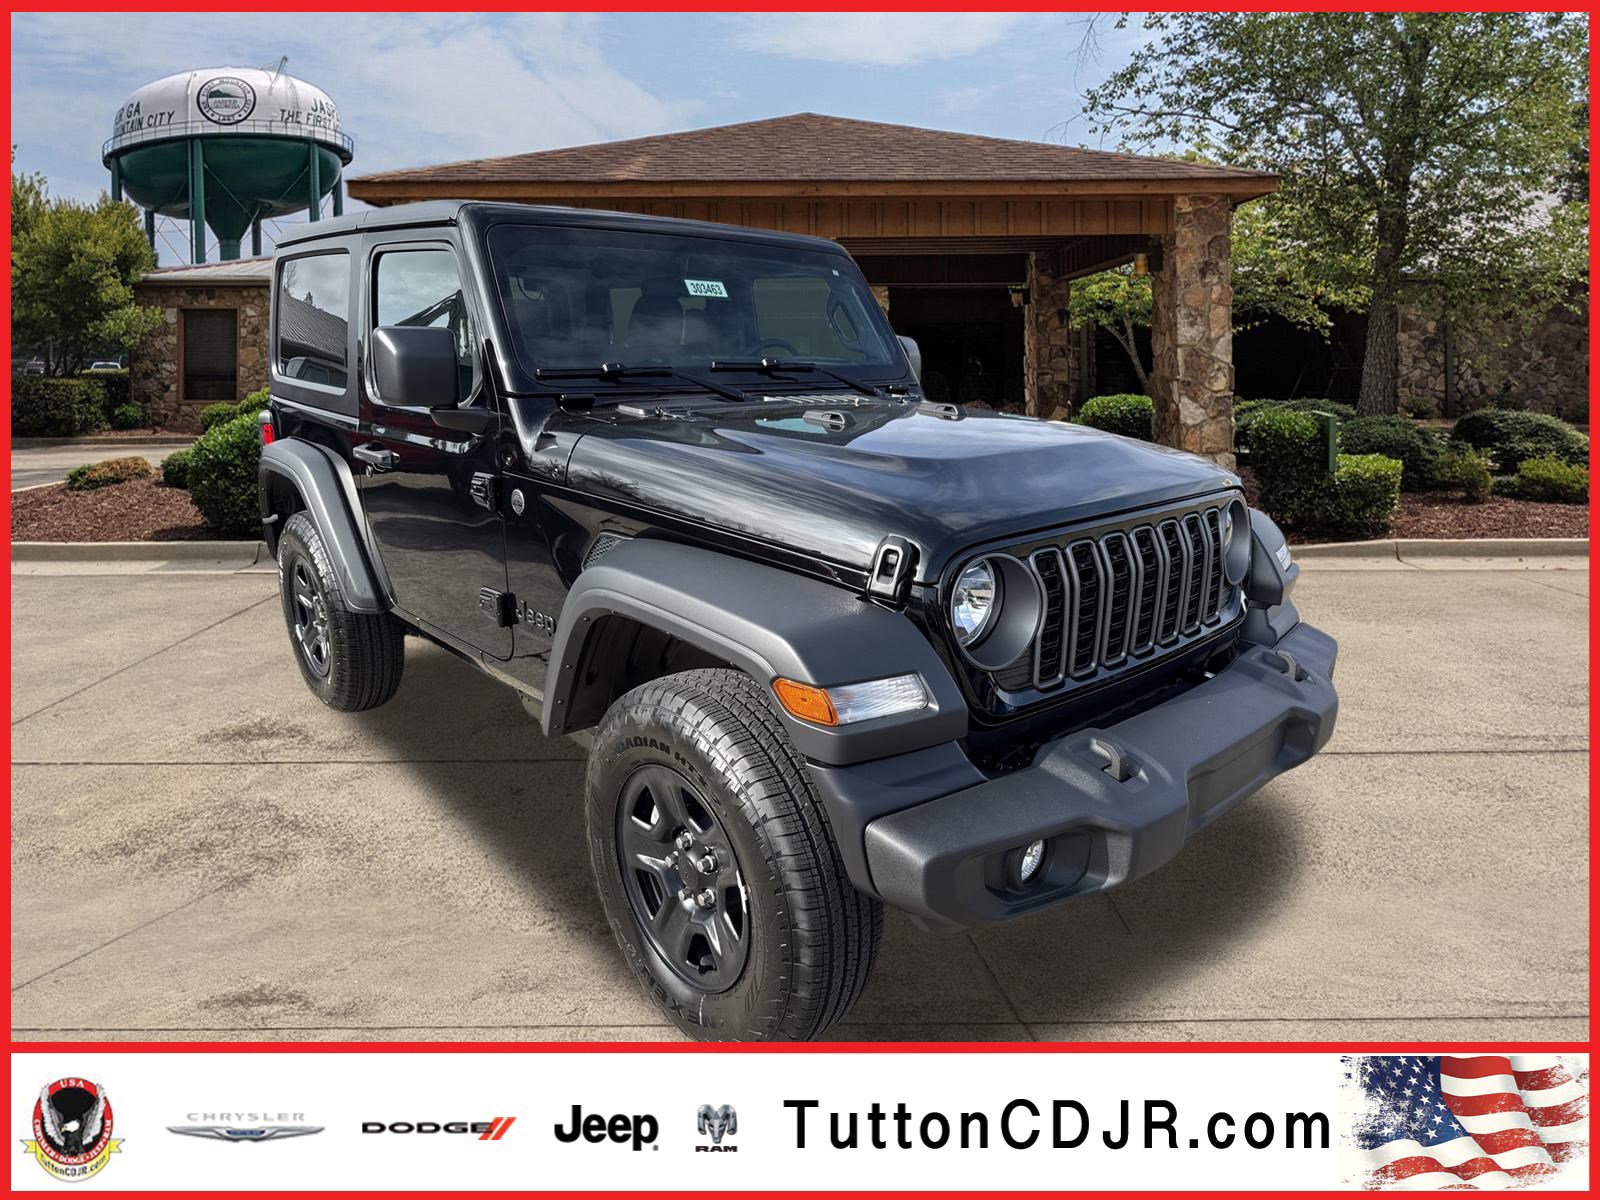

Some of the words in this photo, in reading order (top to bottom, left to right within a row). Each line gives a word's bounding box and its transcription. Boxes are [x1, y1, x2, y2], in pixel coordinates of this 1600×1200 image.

[126, 100, 141, 119] GA
[280, 108, 303, 124] THE
[147, 110, 176, 128] CITY
[690, 282, 723, 296] 303463
[515, 599, 557, 637] Jeep
